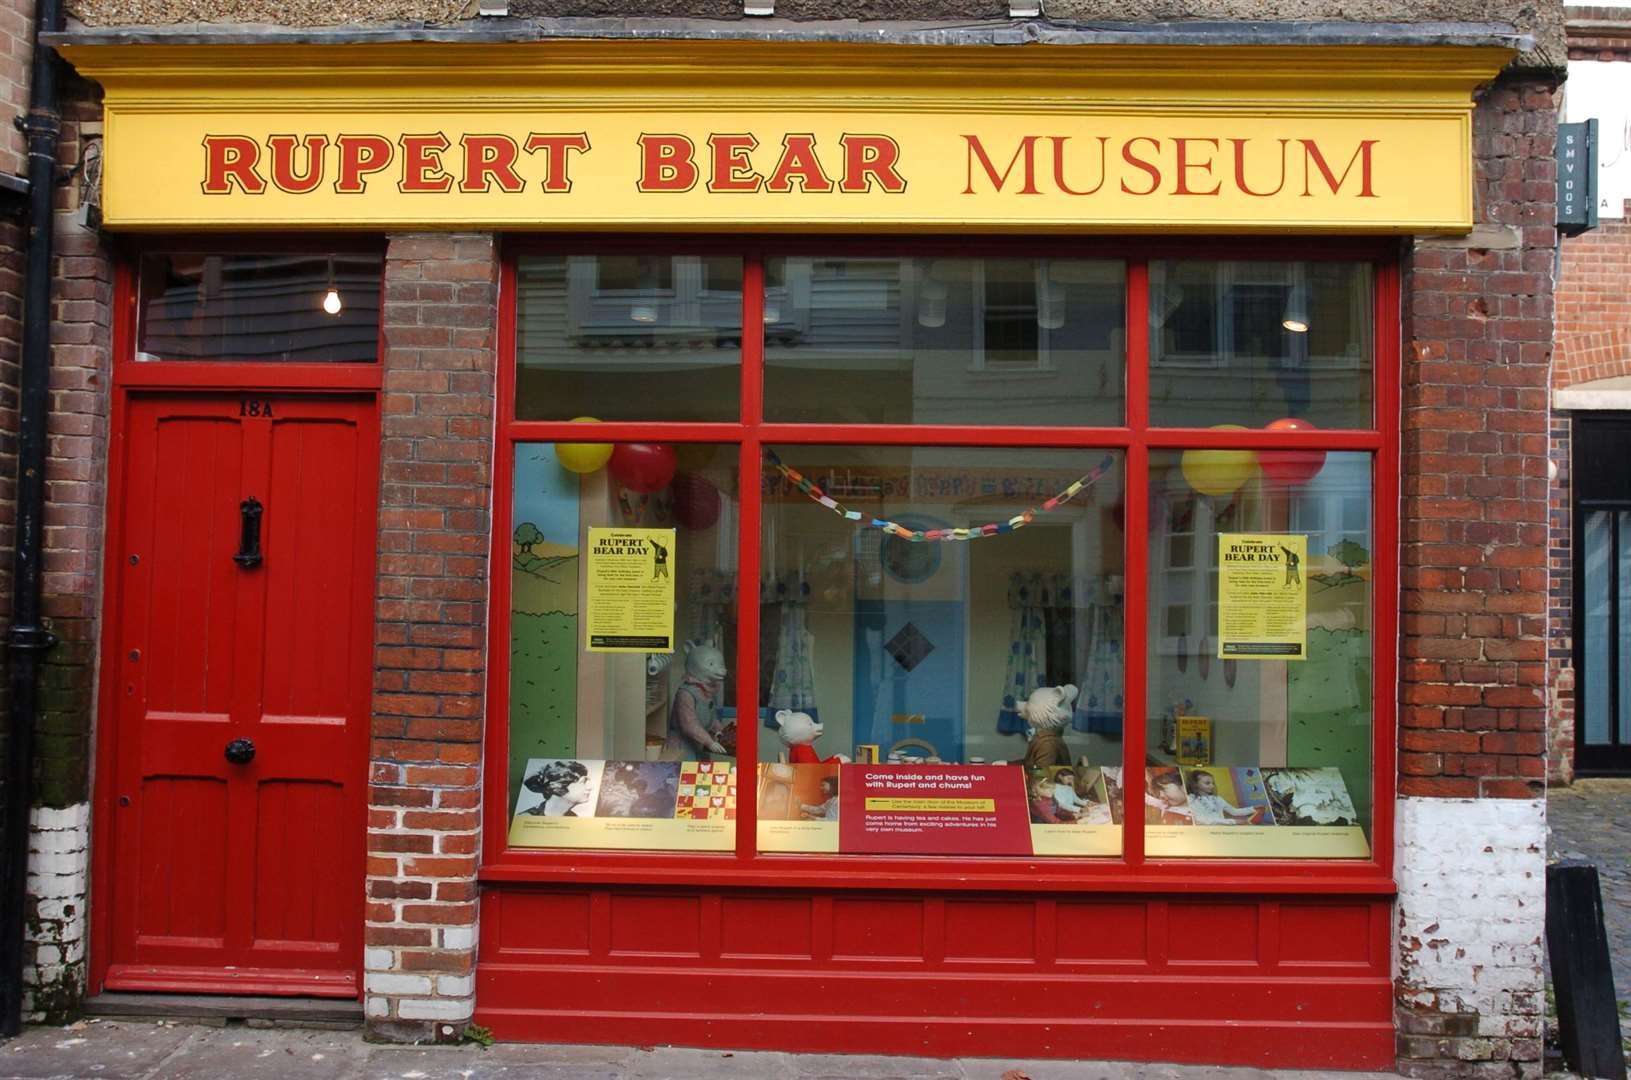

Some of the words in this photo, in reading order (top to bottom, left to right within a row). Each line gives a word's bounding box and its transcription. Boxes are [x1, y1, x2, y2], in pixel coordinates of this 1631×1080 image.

[200, 130, 592, 195] RUPERT
[636, 131, 908, 194] BEAR
[958, 134, 1382, 198] MUSEUM
[240, 400, 273, 417] 18A
[599, 538, 645, 547] RUPERT
[593, 547, 624, 555] BEAR
[627, 547, 650, 556] DAY
[1230, 545, 1276, 553] RUPERT
[1224, 553, 1256, 561] BEAR
[1258, 553, 1281, 562] DAY
[865, 773, 894, 781] Come
[896, 773, 923, 781] inside
[886, 781, 916, 789] Rupert
